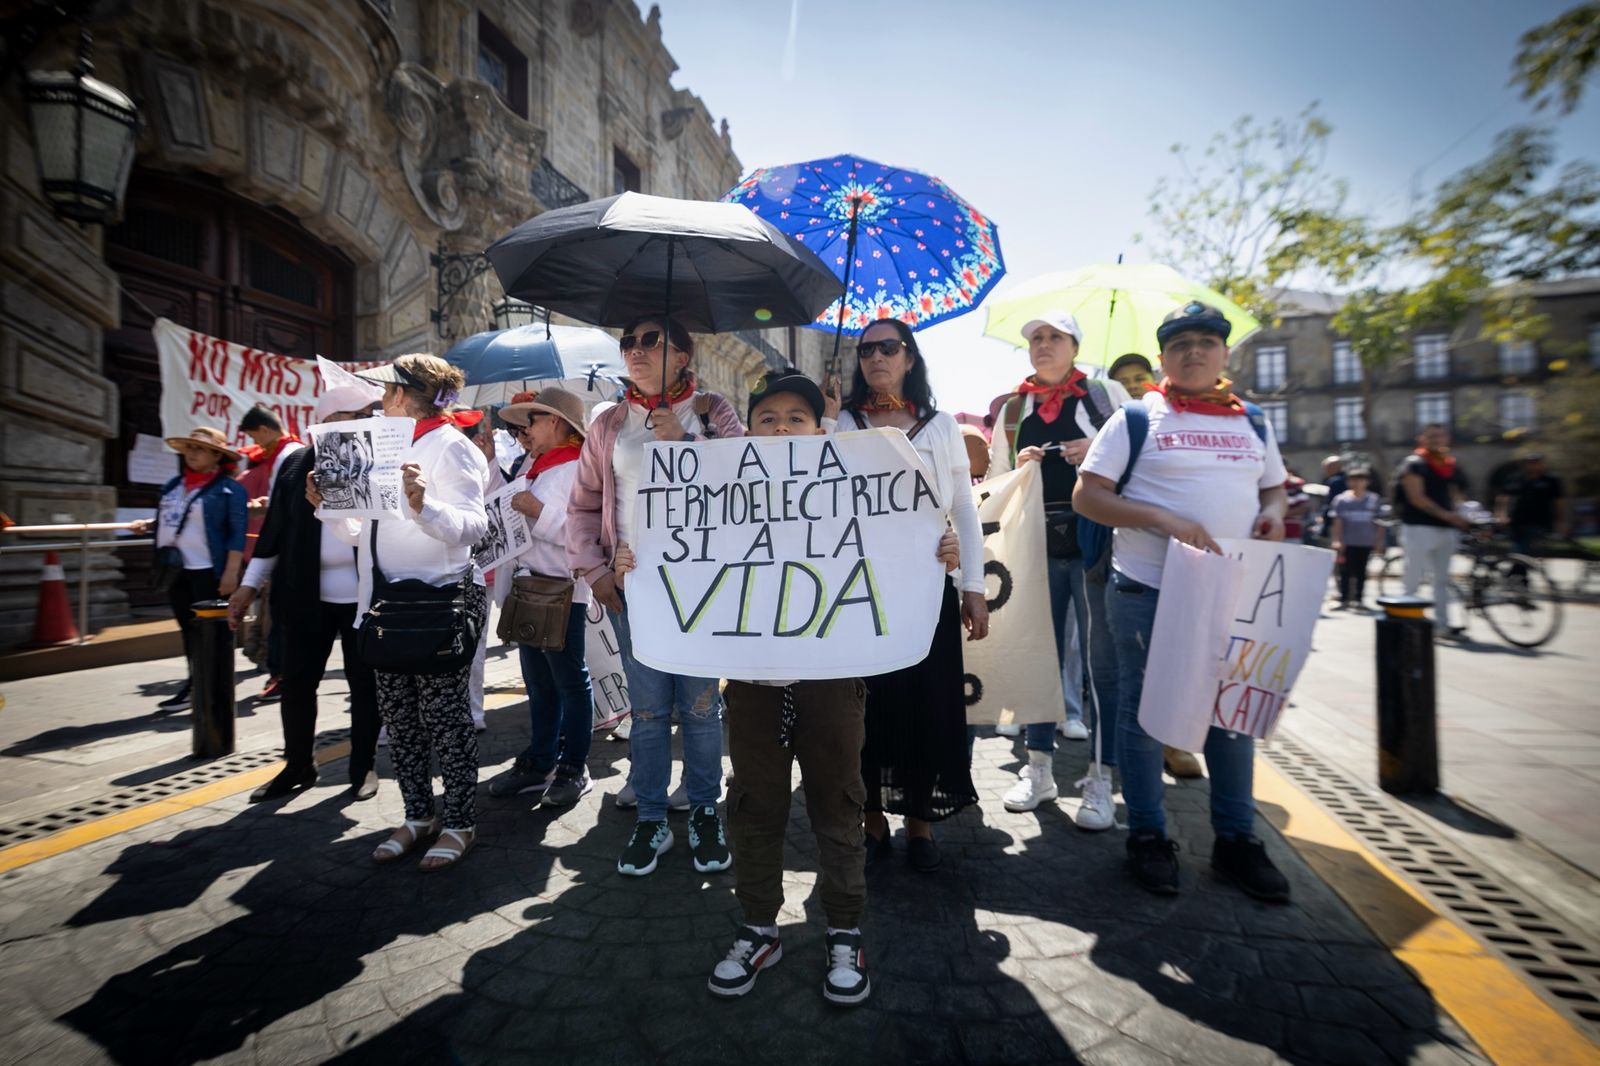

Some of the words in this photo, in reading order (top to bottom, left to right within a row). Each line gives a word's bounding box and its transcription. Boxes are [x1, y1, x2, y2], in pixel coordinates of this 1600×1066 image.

[189, 332, 230, 385] NO
[239, 347, 304, 396] MAS
[191, 391, 232, 419] POR
[651, 447, 699, 483] NO
[737, 442, 769, 478] A
[789, 440, 847, 478] LA
[638, 469, 940, 529] TERMOELECTRICA
[662, 526, 717, 563] SI
[743, 523, 774, 561] A
[806, 517, 864, 559] LA
[657, 558, 890, 639] VIDA
